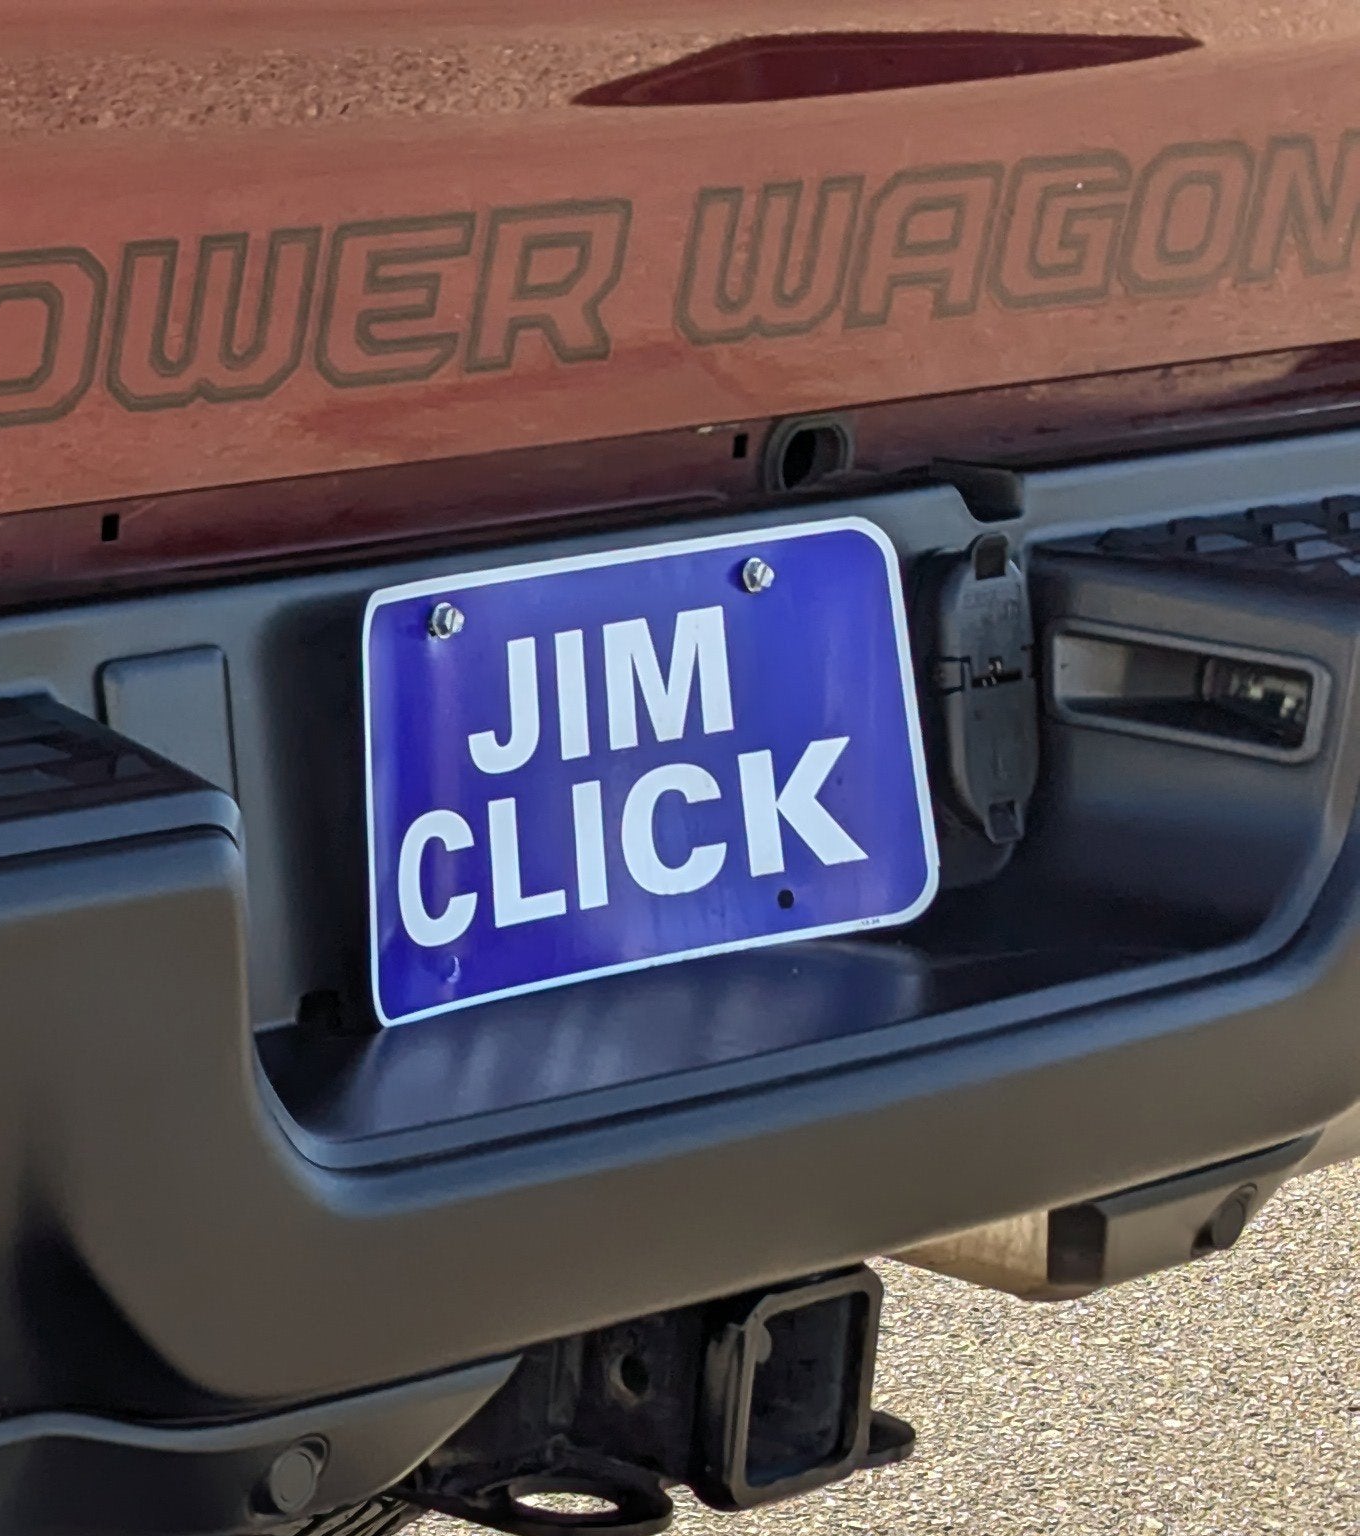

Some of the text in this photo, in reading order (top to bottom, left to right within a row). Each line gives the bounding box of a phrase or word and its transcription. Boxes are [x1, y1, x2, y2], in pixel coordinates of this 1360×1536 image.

[672, 127, 1360, 346] WAGON
[467, 604, 735, 775] JIM
[397, 735, 870, 948] CLICK
